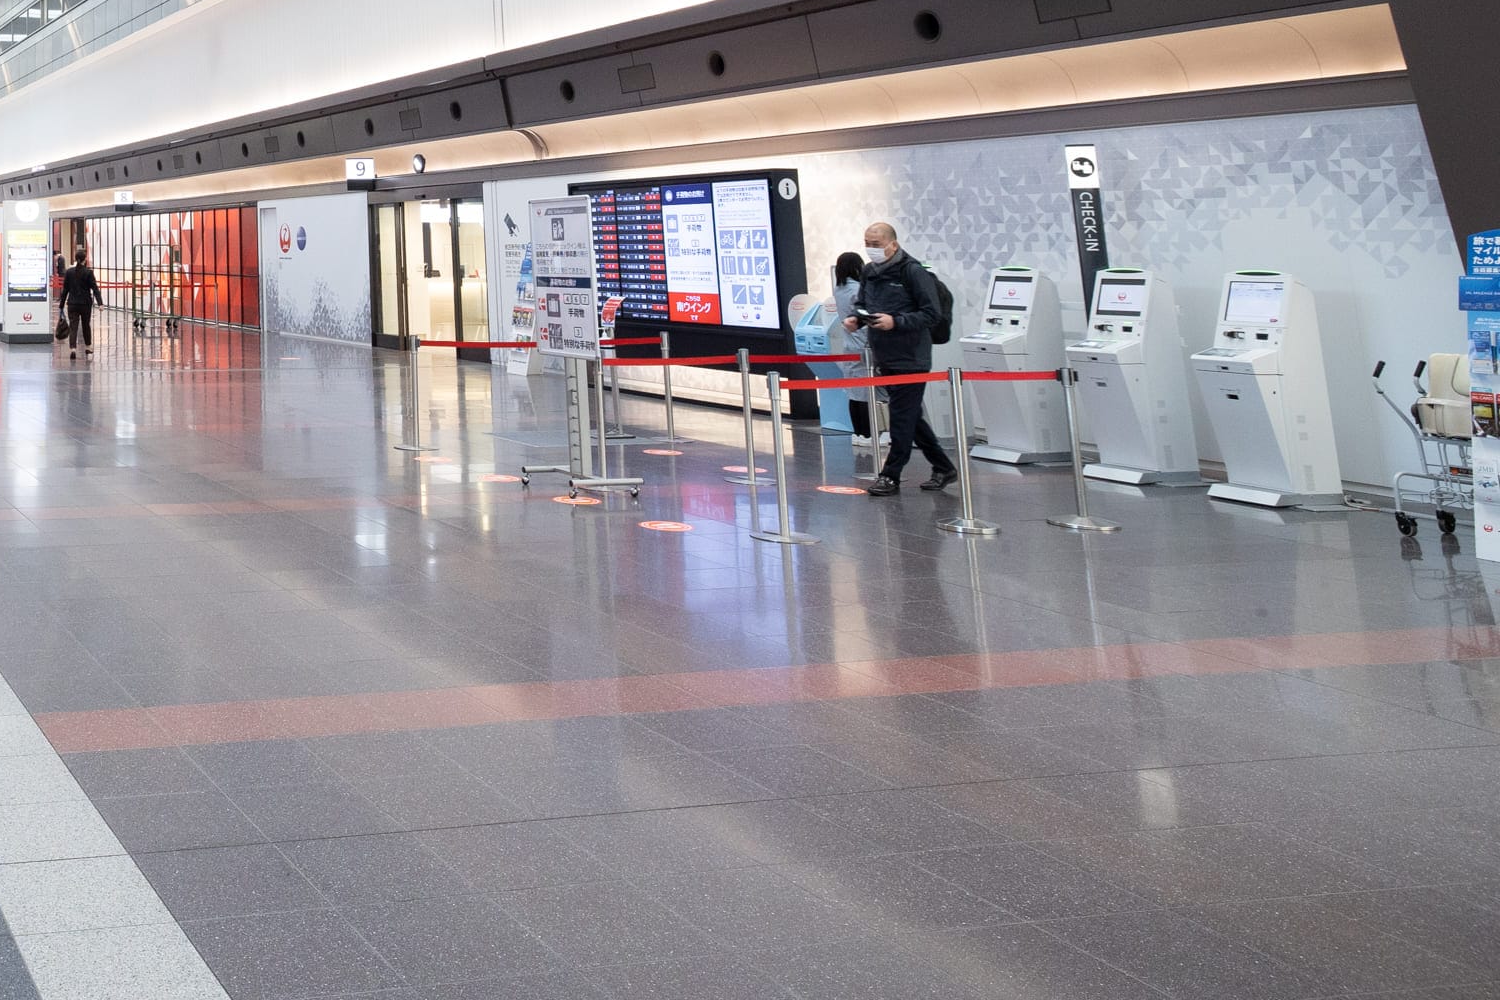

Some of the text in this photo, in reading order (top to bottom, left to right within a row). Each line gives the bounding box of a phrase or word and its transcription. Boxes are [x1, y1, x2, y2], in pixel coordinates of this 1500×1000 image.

[355, 161, 366, 177] 9
[1079, 191, 1100, 252] CHECK-IN
[568, 307, 585, 318] 手荷物
[675, 301, 711, 314] 南ウイング
[563, 338, 596, 351] 特別な手荷物
